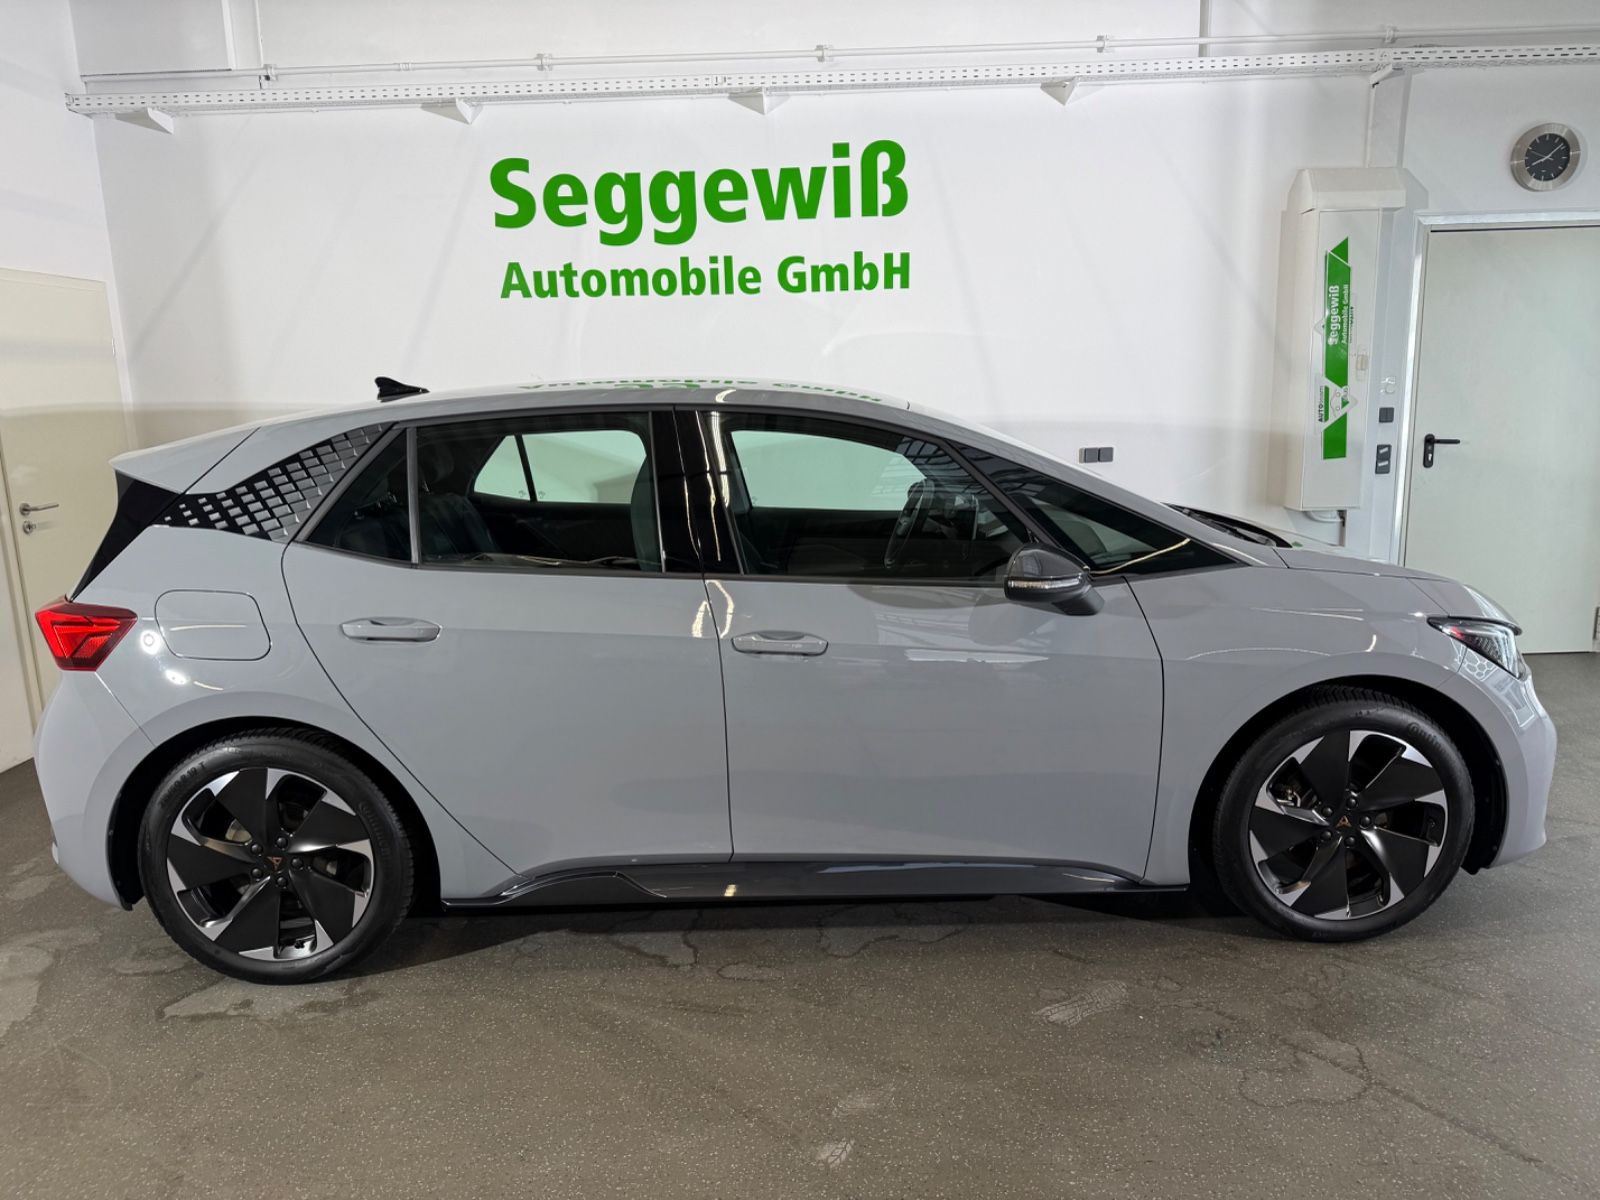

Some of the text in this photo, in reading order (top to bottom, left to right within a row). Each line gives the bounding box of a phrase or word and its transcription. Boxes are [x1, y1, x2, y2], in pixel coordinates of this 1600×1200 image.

[490, 139, 909, 247] Seggewiß
[500, 250, 910, 299] Automobile GmbH
